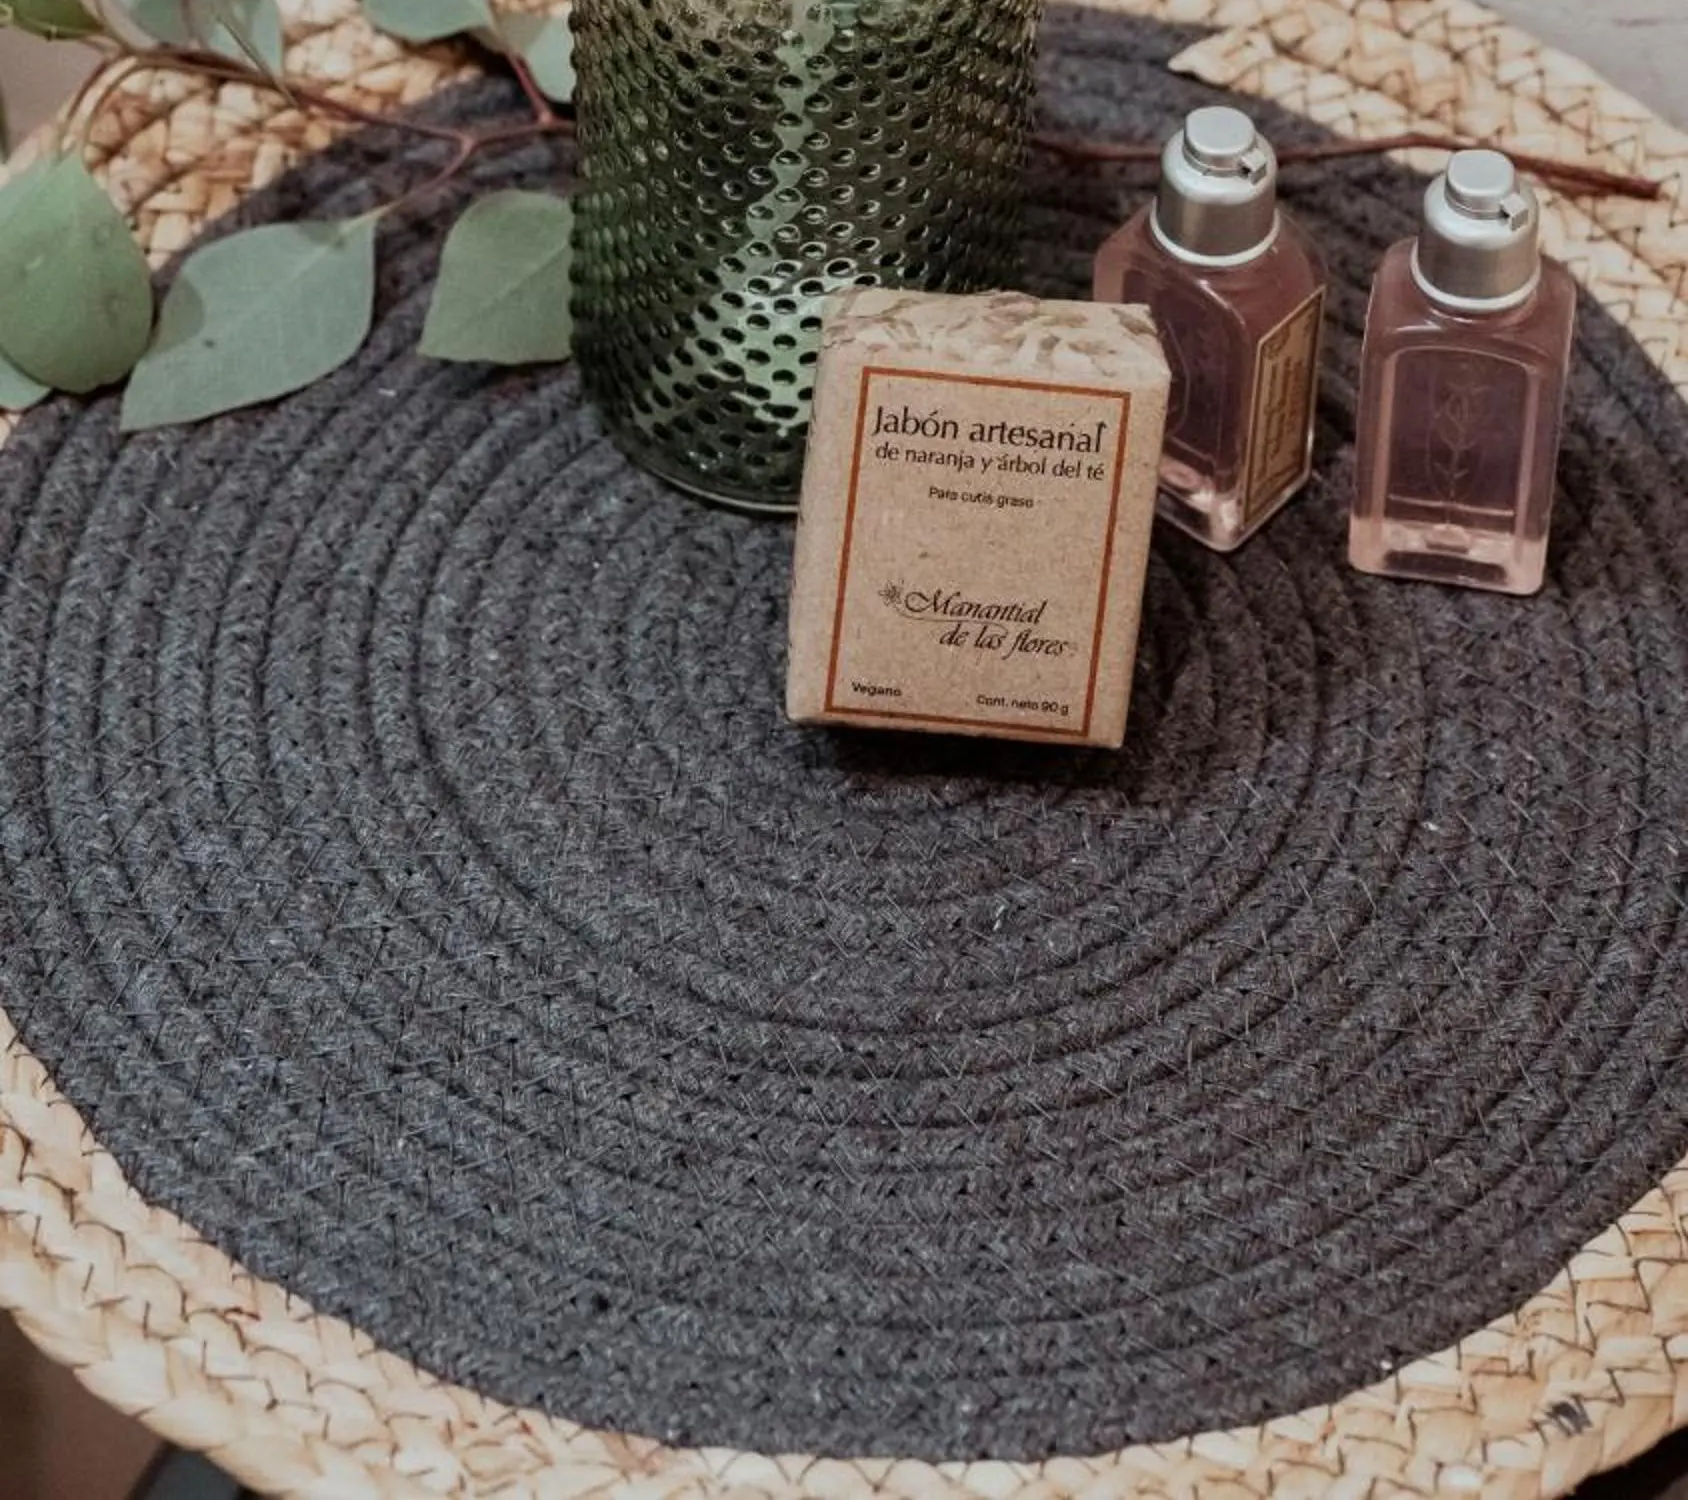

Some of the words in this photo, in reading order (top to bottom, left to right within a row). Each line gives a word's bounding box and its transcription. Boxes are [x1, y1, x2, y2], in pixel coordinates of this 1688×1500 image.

[872, 406, 959, 440] Jabón
[968, 420, 1106, 453] artesanal
[875, 441, 900, 461] de
[905, 448, 975, 472] naranja
[981, 457, 993, 474] y
[997, 453, 1047, 475] árbol
[1052, 461, 1081, 479] del
[1086, 462, 1105, 481] té
[929, 486, 959, 501] Para
[904, 588, 1048, 625] Manantial
[939, 623, 970, 647] de
[974, 625, 1005, 650] las
[1002, 628, 1069, 660] flores
[851, 681, 902, 698] Vegano
[1011, 698, 1039, 711] neto
[1041, 700, 1059, 713] 90
[1060, 705, 1070, 717] g
